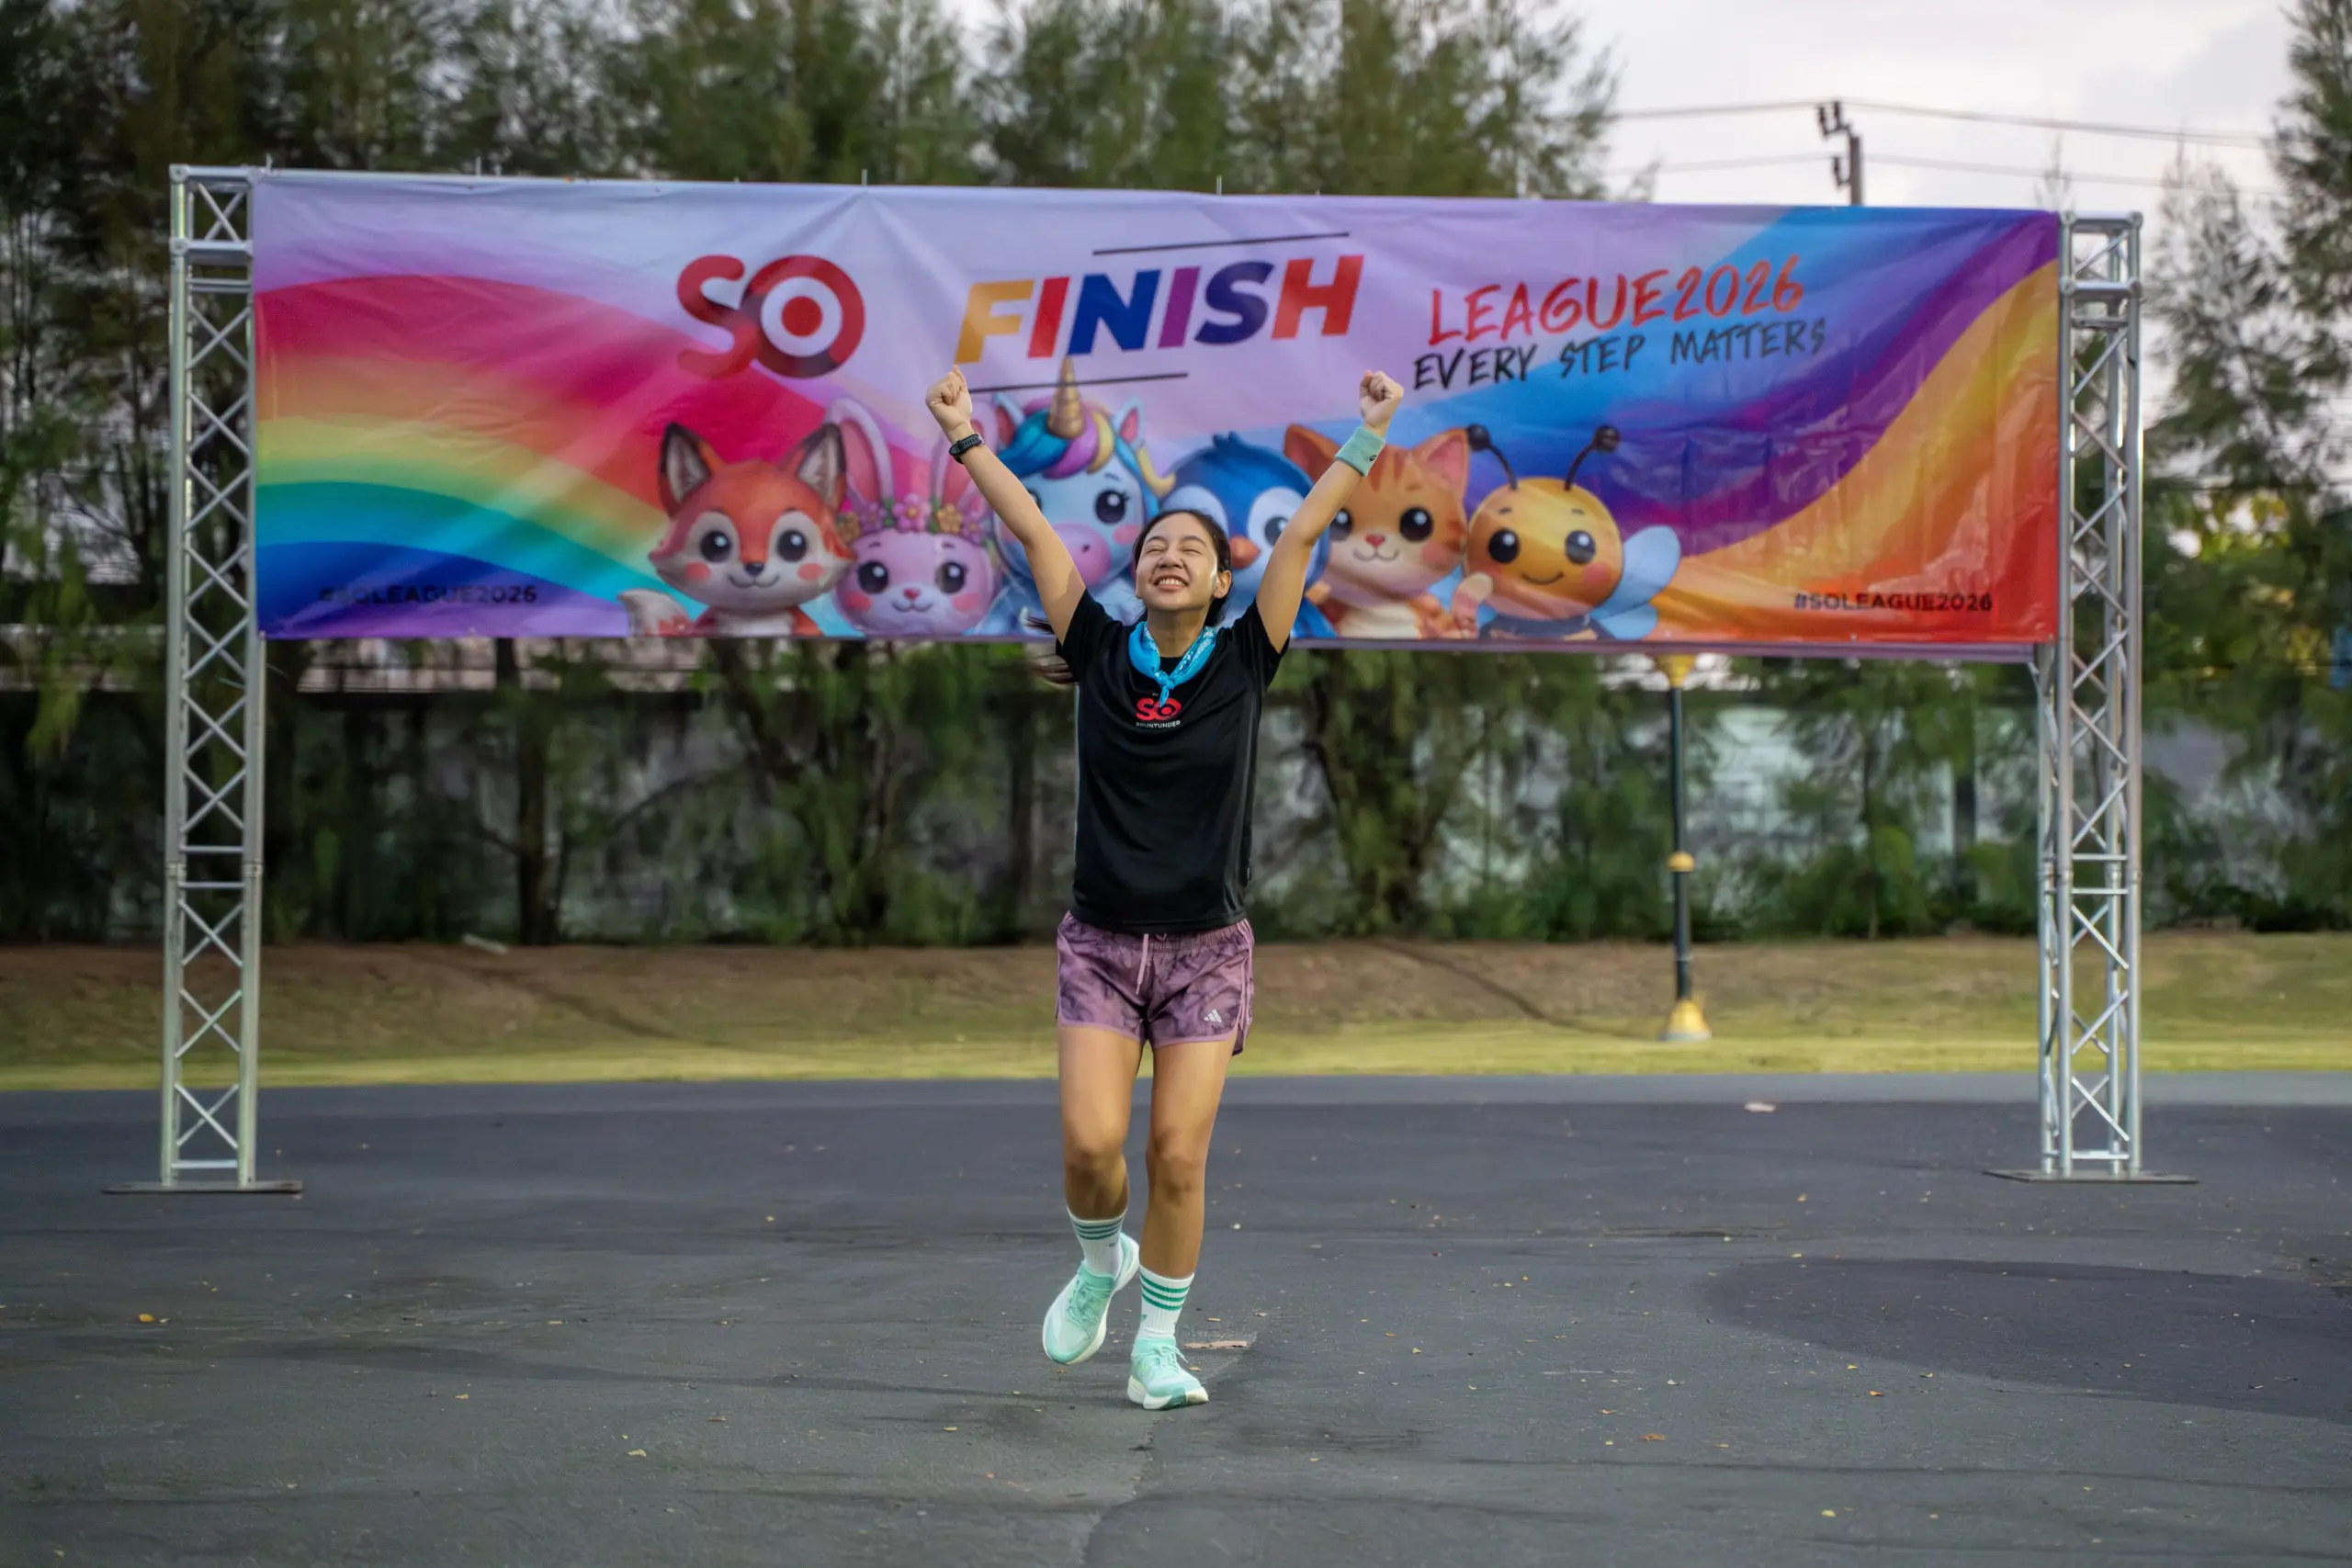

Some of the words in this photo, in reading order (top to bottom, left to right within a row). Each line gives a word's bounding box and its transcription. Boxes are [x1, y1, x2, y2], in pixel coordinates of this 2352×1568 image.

[676, 254, 865, 379] SO
[956, 255, 1365, 364] FINISH
[1428, 254, 1804, 346] LEAGUE2026
[1413, 344, 1539, 391] EVERY
[1560, 334, 1646, 378] STEP
[1669, 318, 1826, 366] MATTERS
[319, 584, 538, 605] #OLEAGUE2026
[1793, 592, 1993, 613] #SOLEAGUE2026
[1136, 697, 1182, 721] SO
